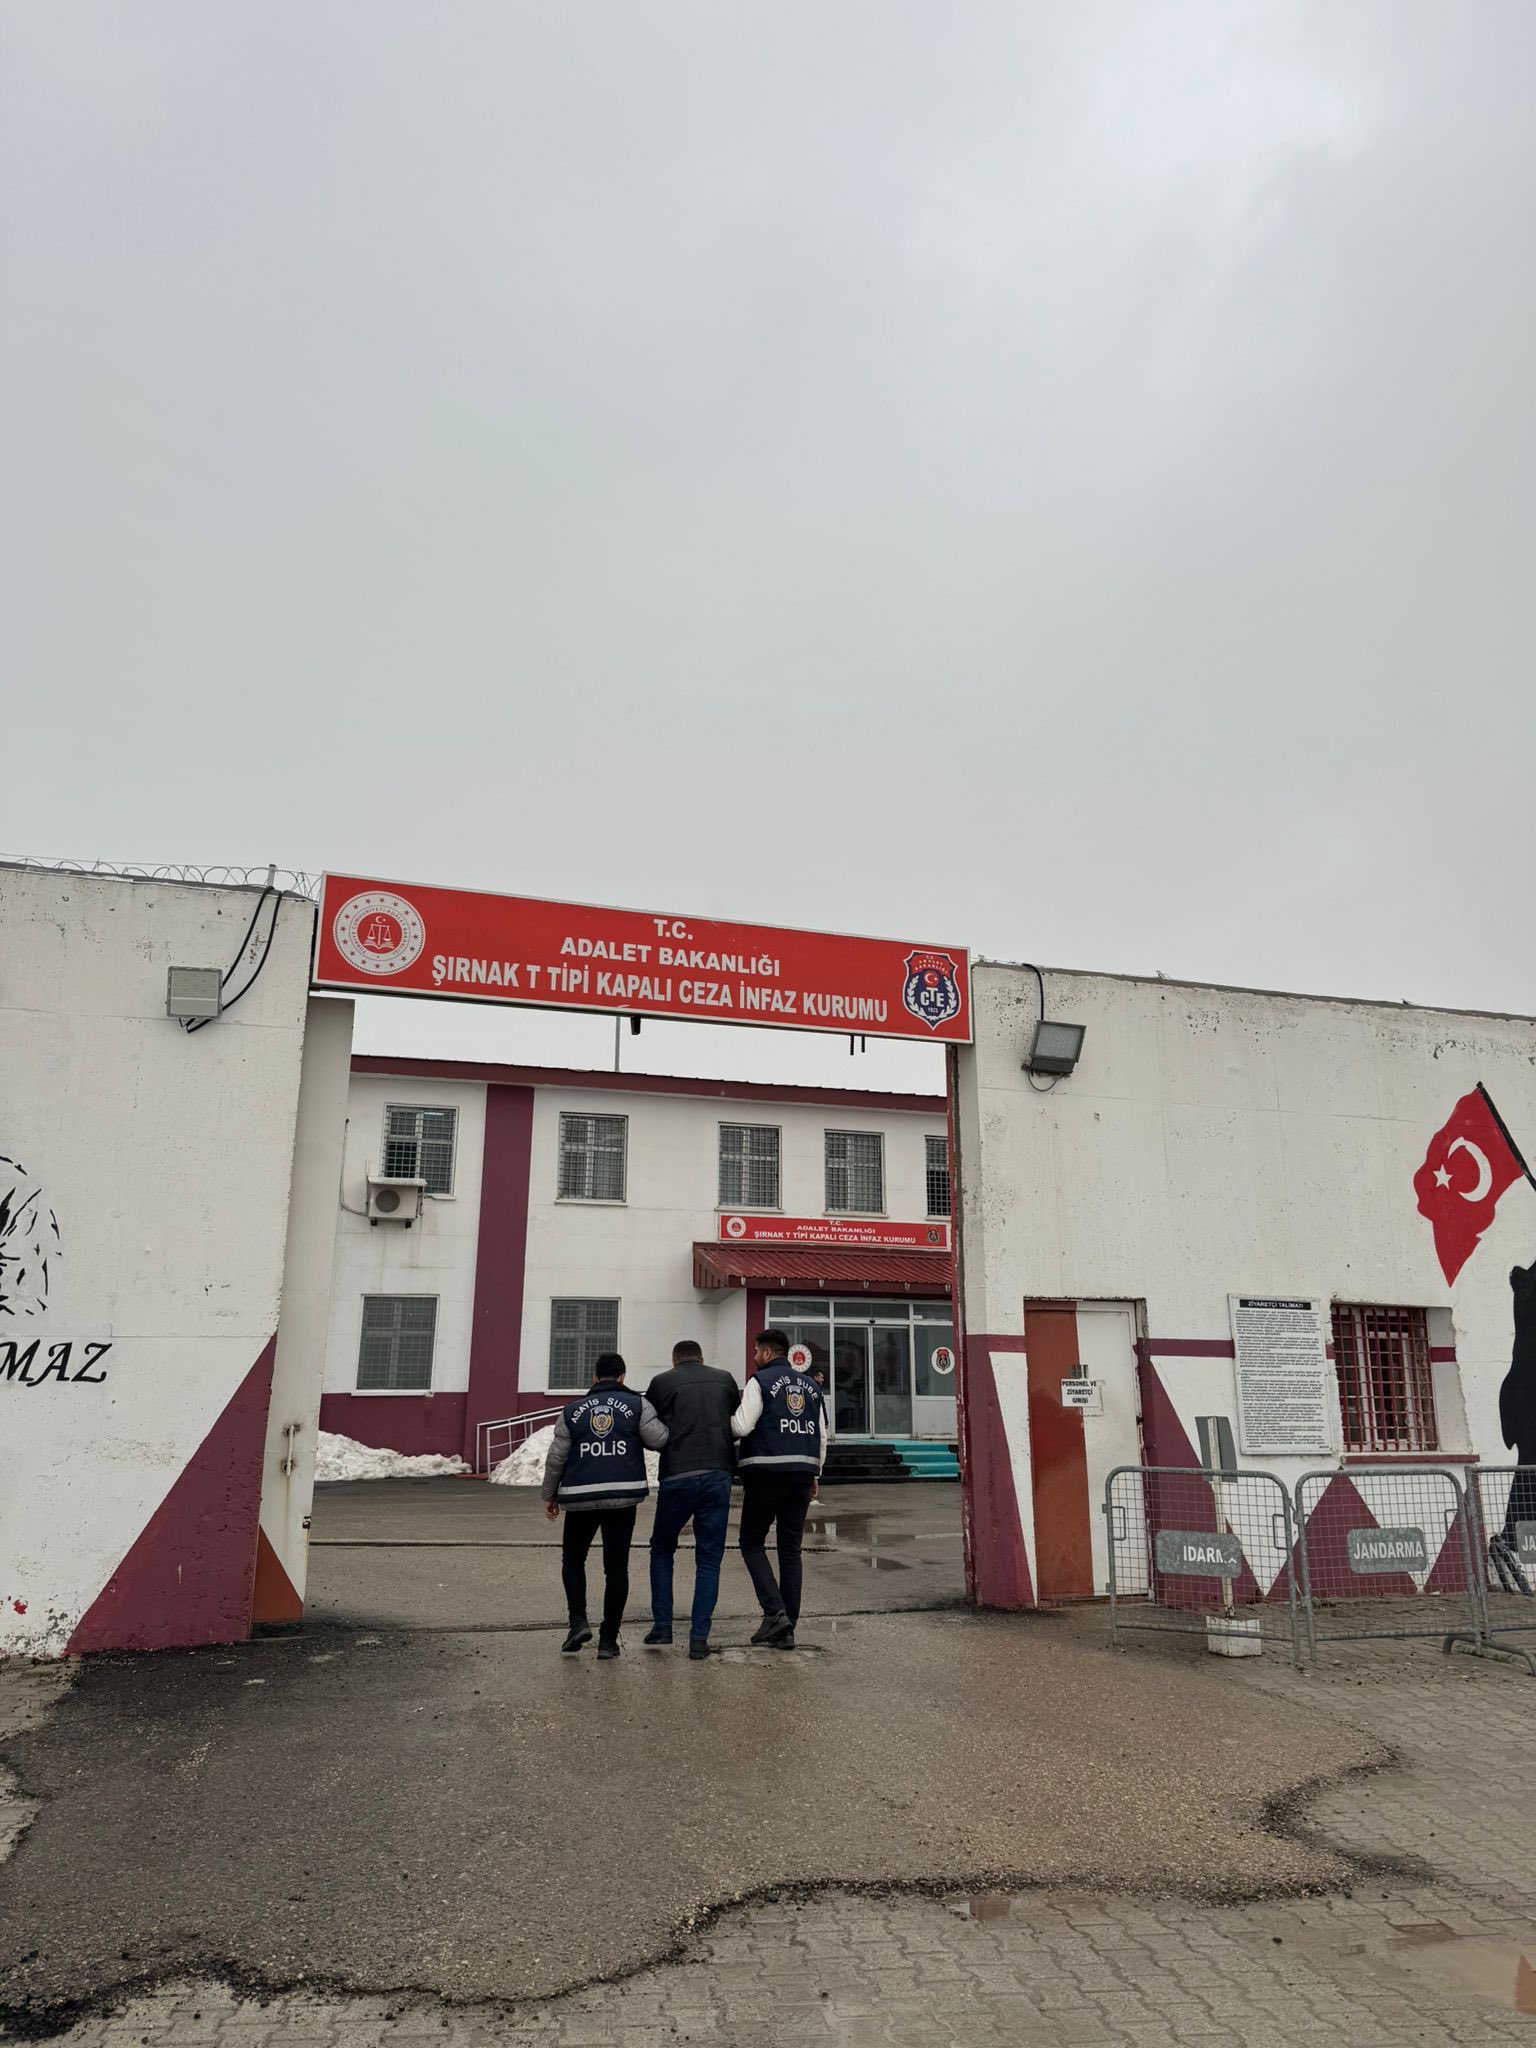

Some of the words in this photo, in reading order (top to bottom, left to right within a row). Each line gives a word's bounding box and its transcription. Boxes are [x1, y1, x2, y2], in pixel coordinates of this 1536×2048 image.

[653, 919, 693, 940] T.C.
[560, 937, 651, 962] ADALET
[659, 947, 780, 976] BAKANLIĞI
[432, 954, 519, 986] ŞIRNAK
[526, 964, 541, 989] T
[547, 962, 589, 993] TİPİ
[596, 971, 672, 1001] KAPALI
[679, 980, 733, 1007] CEZA
[740, 980, 797, 1013] İNFAZ
[803, 992, 888, 1022] KURUMU
[920, 987, 945, 1007] CTE
[754, 1231, 784, 1239] ŞIRNAK
[883, 1236, 916, 1244] KURUMU
[1353, 1541, 1424, 1560] JANDARMA
